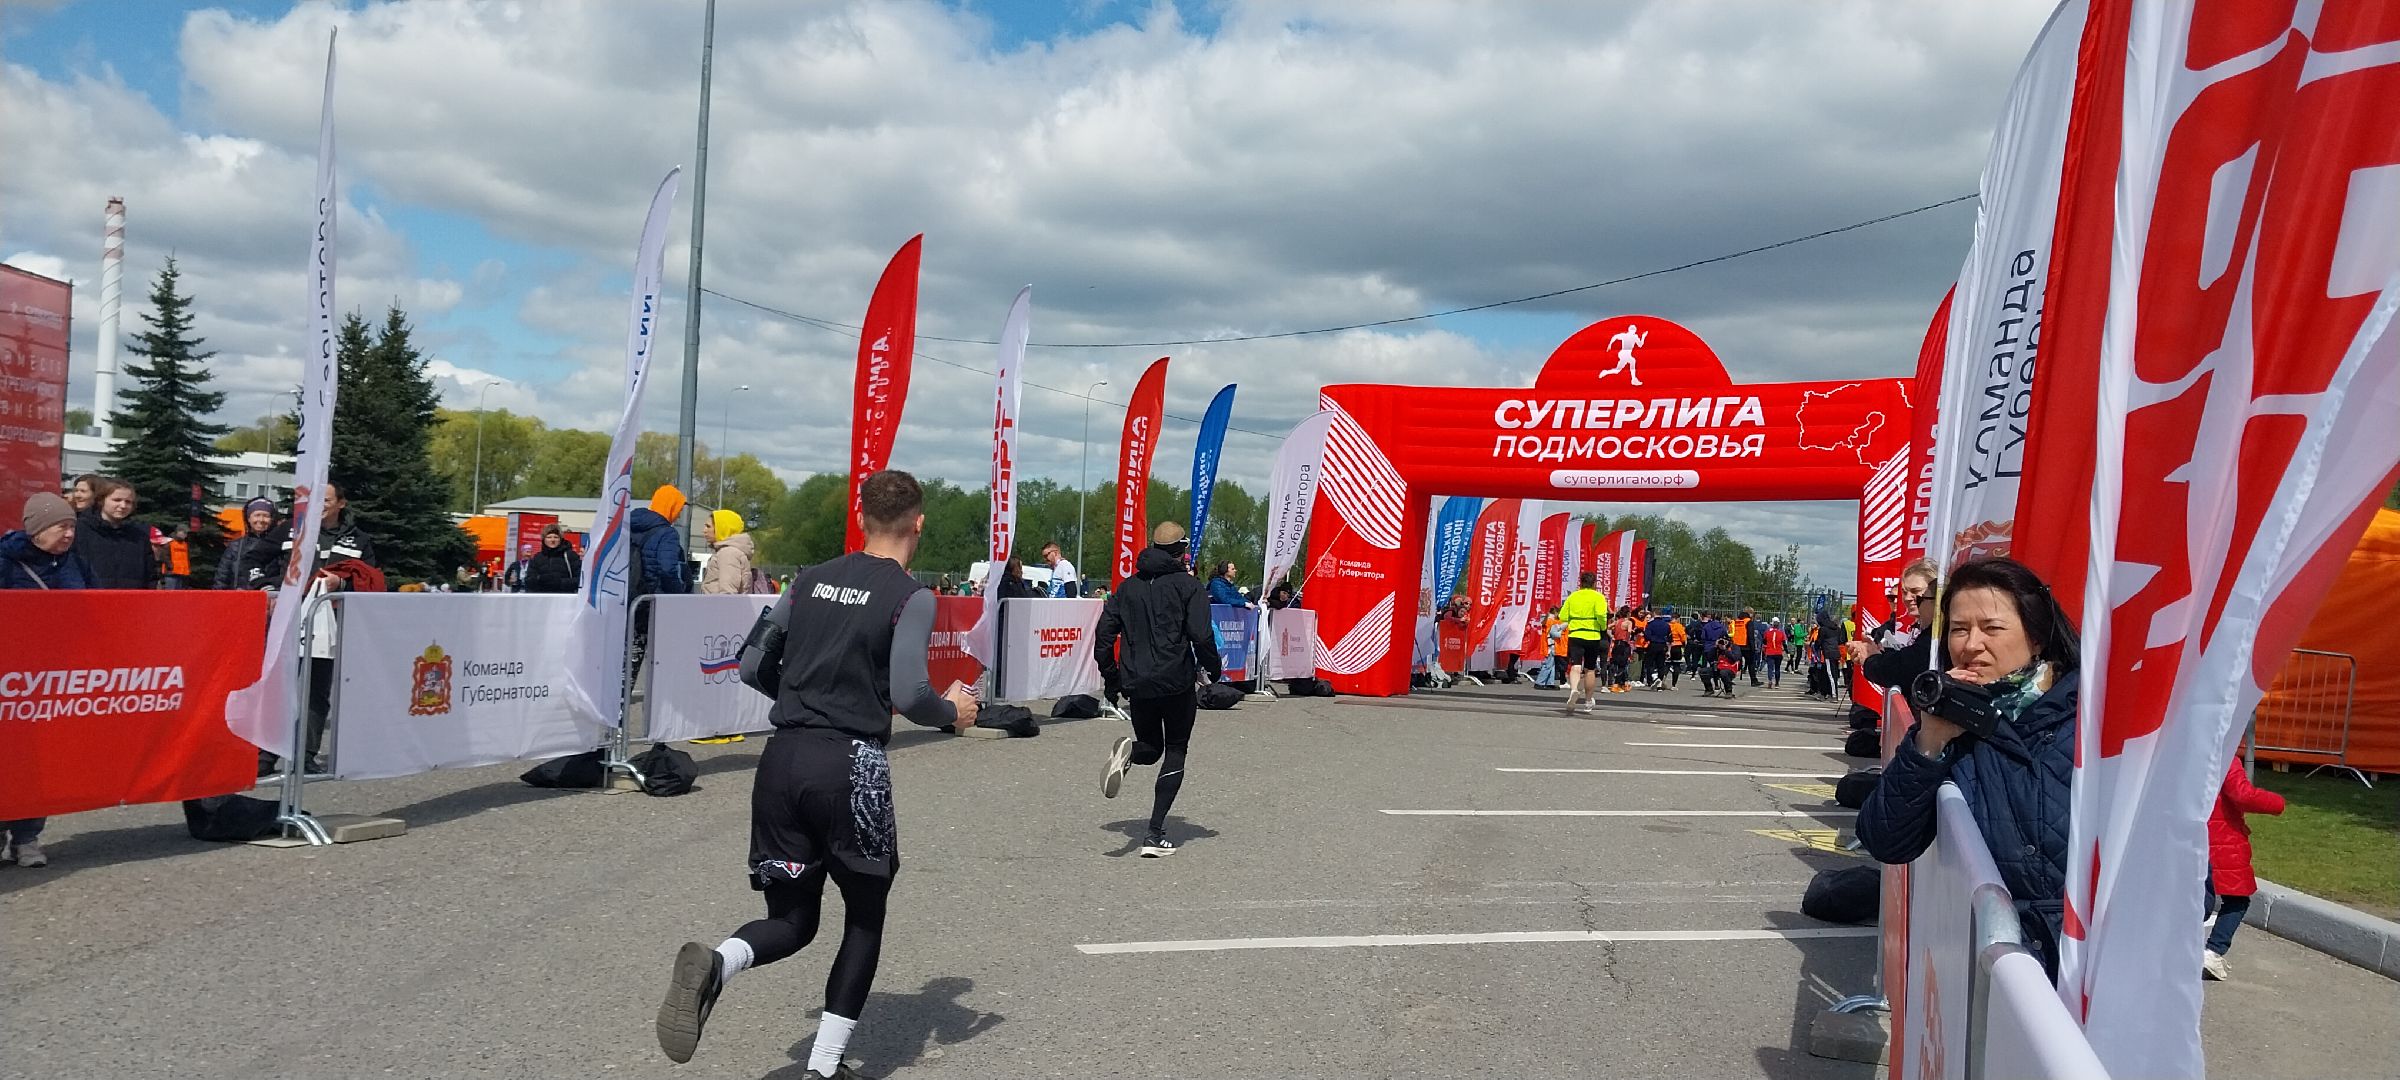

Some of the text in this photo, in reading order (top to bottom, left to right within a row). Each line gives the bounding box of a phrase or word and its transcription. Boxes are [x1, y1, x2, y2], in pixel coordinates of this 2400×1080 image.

[1494, 396, 1766, 429] СУПЕРЛИГА
[1492, 434, 1766, 462] ПОДМОСКОВЬЯ
[1564, 474, 1685, 486] суперлигамо.рф
[1338, 568, 1385, 580] Губернатора
[1340, 559, 1371, 569] Команда
[1480, 520, 1498, 606] СУПЕРЛИГА
[1514, 541, 1531, 606] СПОРТ
[1534, 539, 1548, 600] БЕГОВАЯ ЛИГА
[1040, 627, 1082, 642] МОСОБЛ
[1040, 643, 1073, 658] СПОРТ
[0, 665, 184, 698] СУПЕРЛИГА
[463, 660, 524, 678] Команда
[0, 692, 184, 723] ПОДМОСКОВЬЯ
[461, 684, 550, 707] Губернатора
